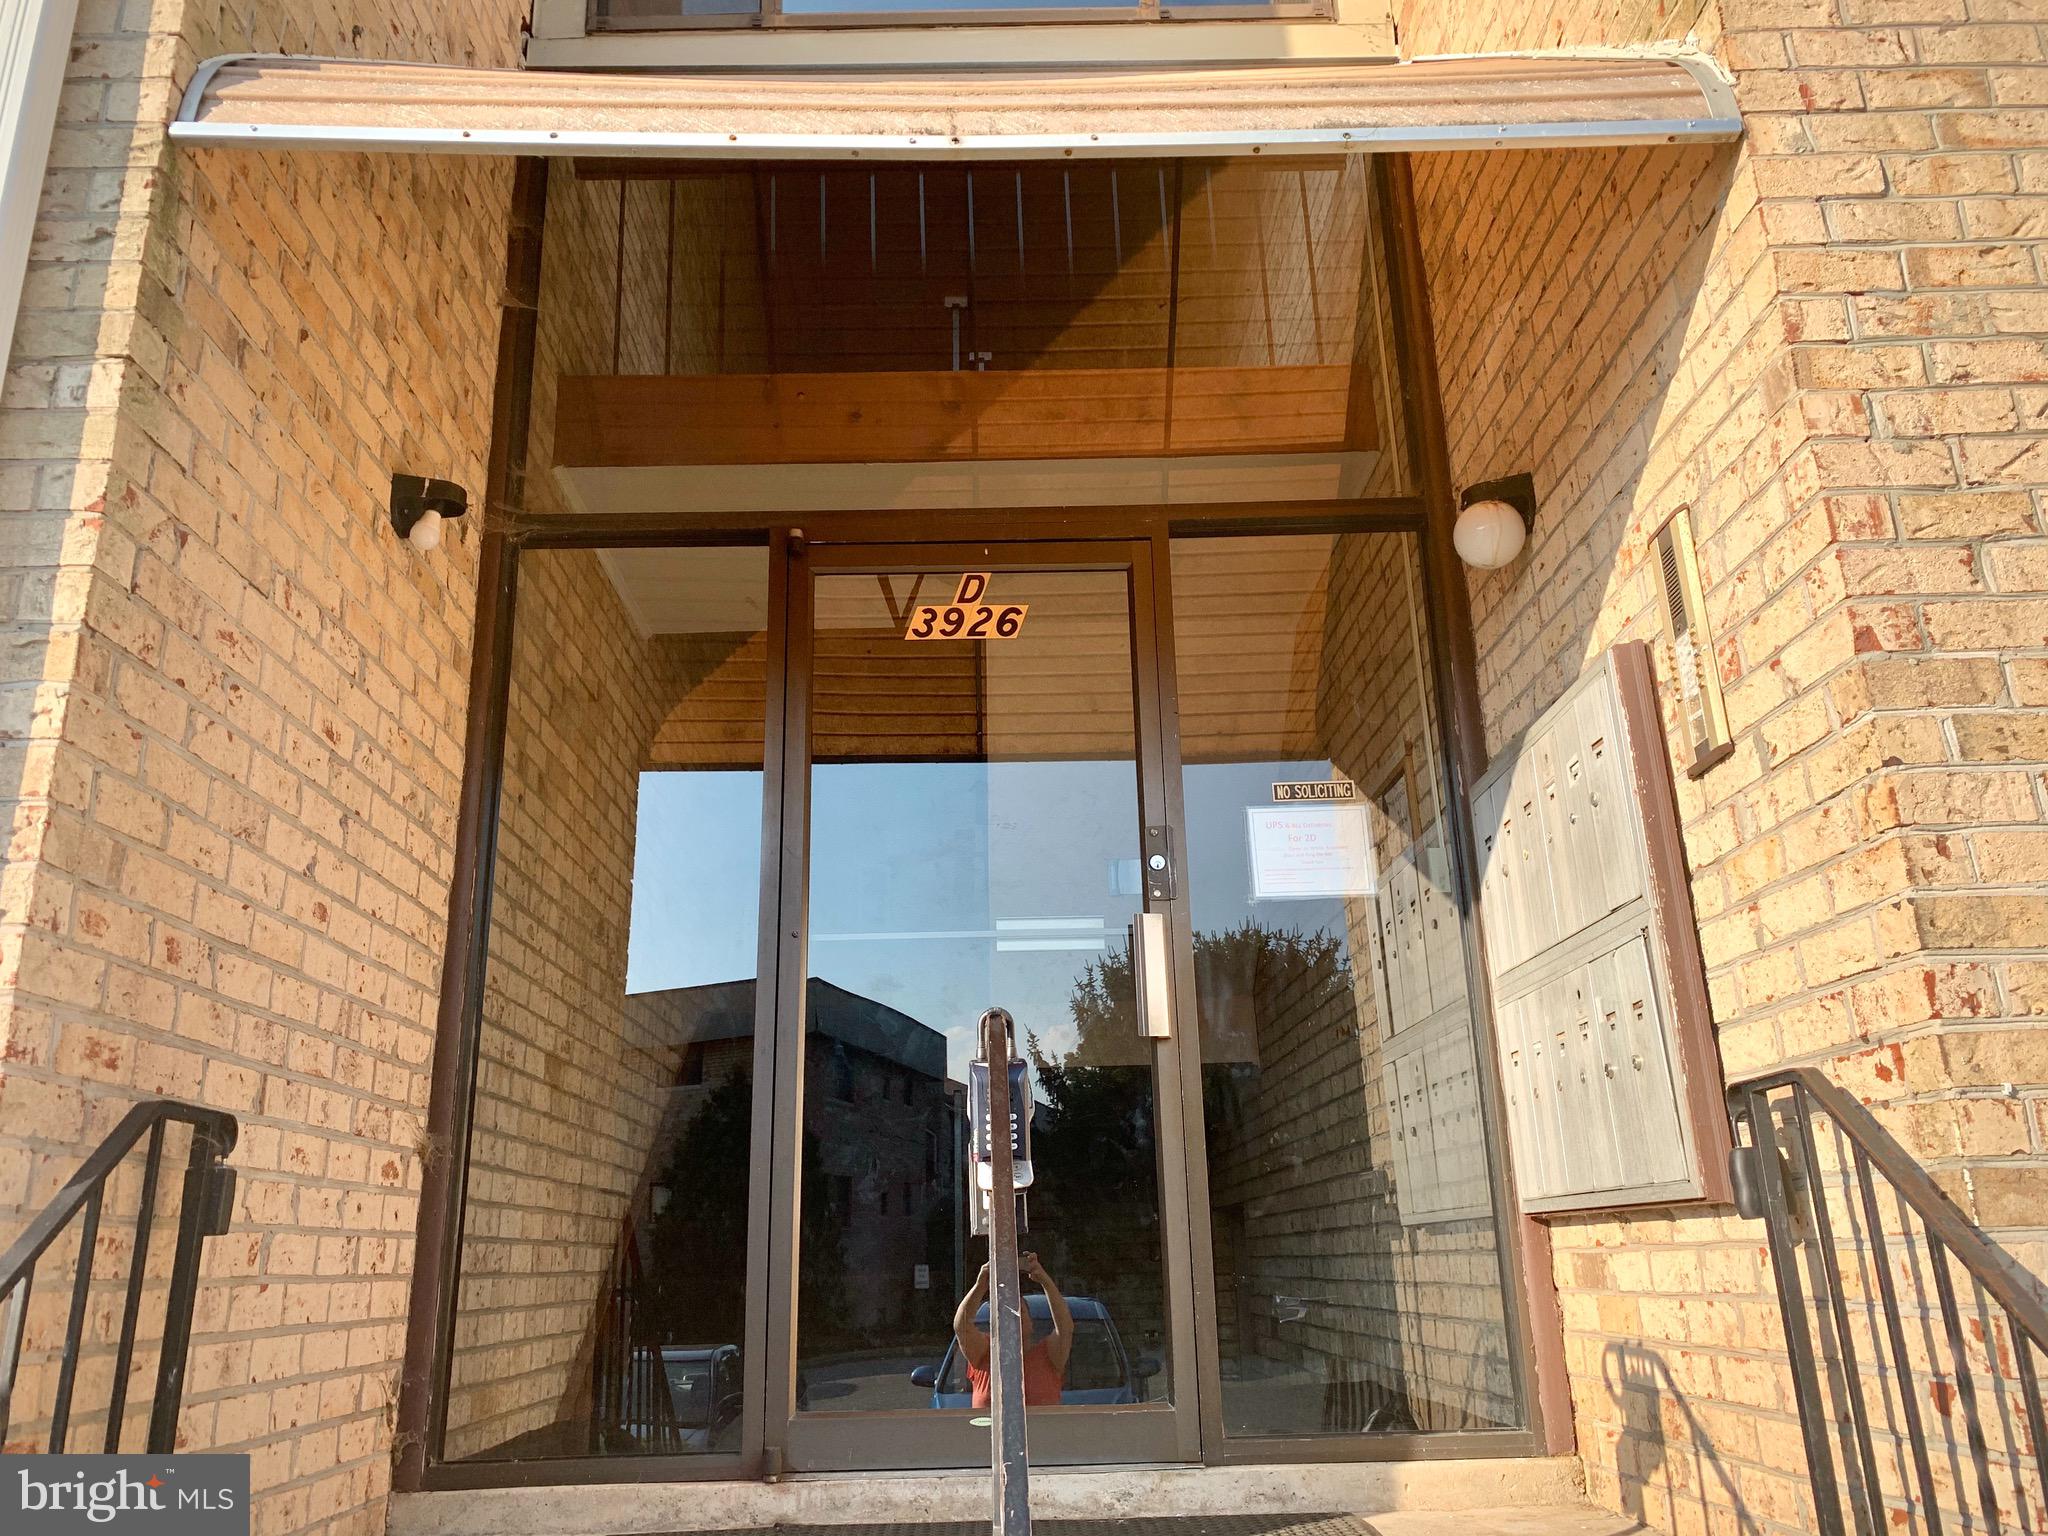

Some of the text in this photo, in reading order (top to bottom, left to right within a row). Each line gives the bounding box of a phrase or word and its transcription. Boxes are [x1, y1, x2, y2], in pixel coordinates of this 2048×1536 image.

[956, 574, 986, 603] D
[911, 606, 1023, 638] 3926
[1277, 783, 1352, 799] NO SOLICITING
